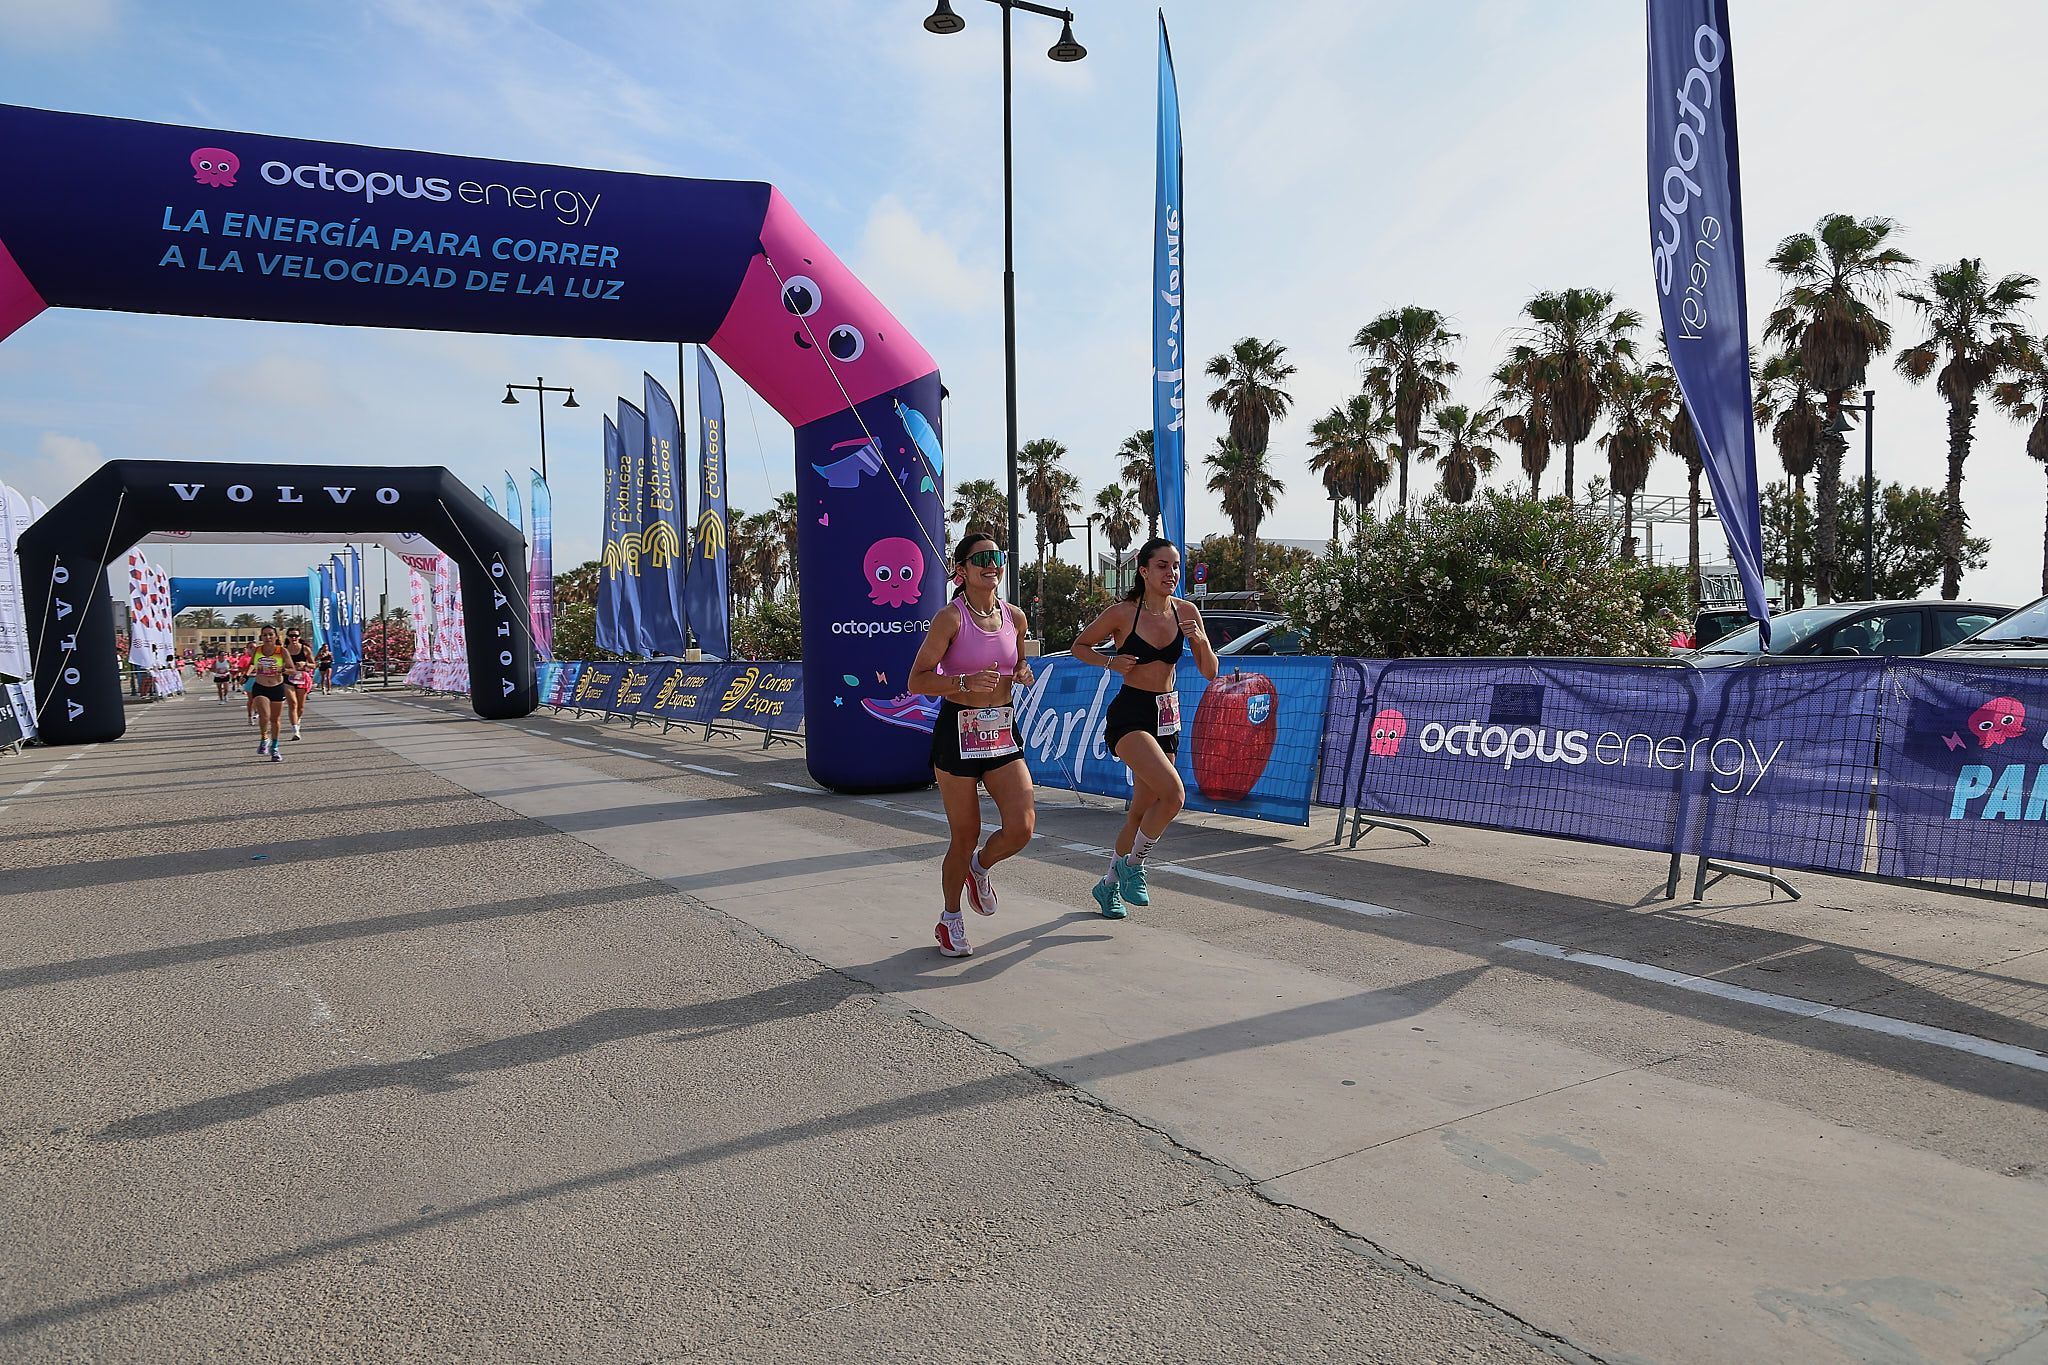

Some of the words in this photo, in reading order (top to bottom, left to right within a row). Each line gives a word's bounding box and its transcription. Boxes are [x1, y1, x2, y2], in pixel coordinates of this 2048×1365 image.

[260, 161, 452, 204] octopus
[458, 181, 601, 227] energy
[162, 206, 210, 234] LA
[222, 212, 380, 249] ENERGÍA
[390, 228, 481, 258] PARA
[492, 237, 619, 268] CORRER
[158, 245, 186, 268] A
[198, 248, 244, 273] LA
[257, 253, 457, 288] VELOCIDAD
[465, 270, 510, 293] DE
[516, 273, 555, 296] LA
[564, 277, 625, 300] LUZ
[168, 483, 400, 504] VOLVO
[53, 566, 85, 722] VOLVO
[491, 562, 516, 698] VOLVO
[831, 620, 902, 638] octopus
[903, 619, 931, 633] ene
[1419, 719, 1589, 770] octopus
[1595, 731, 1784, 796] energy
